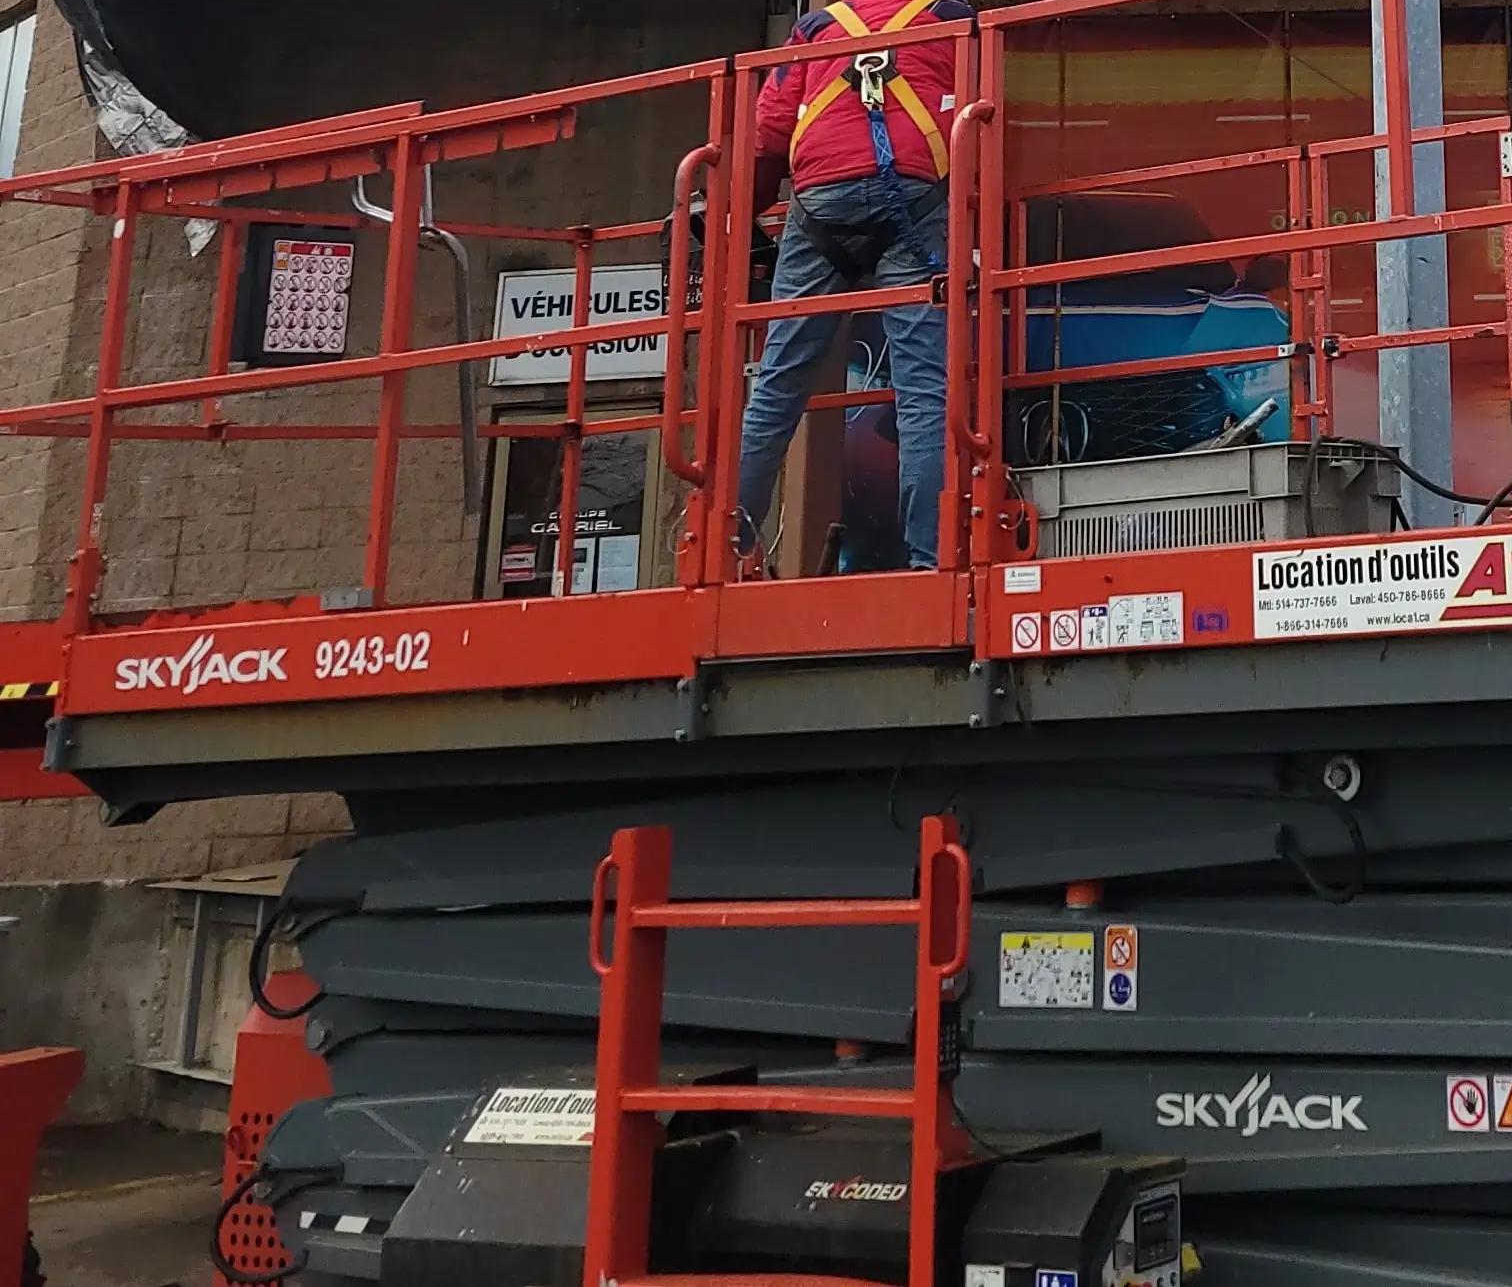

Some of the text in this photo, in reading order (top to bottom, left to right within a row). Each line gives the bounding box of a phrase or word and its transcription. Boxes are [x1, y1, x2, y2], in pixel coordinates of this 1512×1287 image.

[511, 289, 661, 319] VÉHIULES
[1257, 545, 1460, 590] Location d'outils
[115, 631, 431, 695] SKYJACK 9243-02
[1156, 1072, 1369, 1137] SKYJACK
